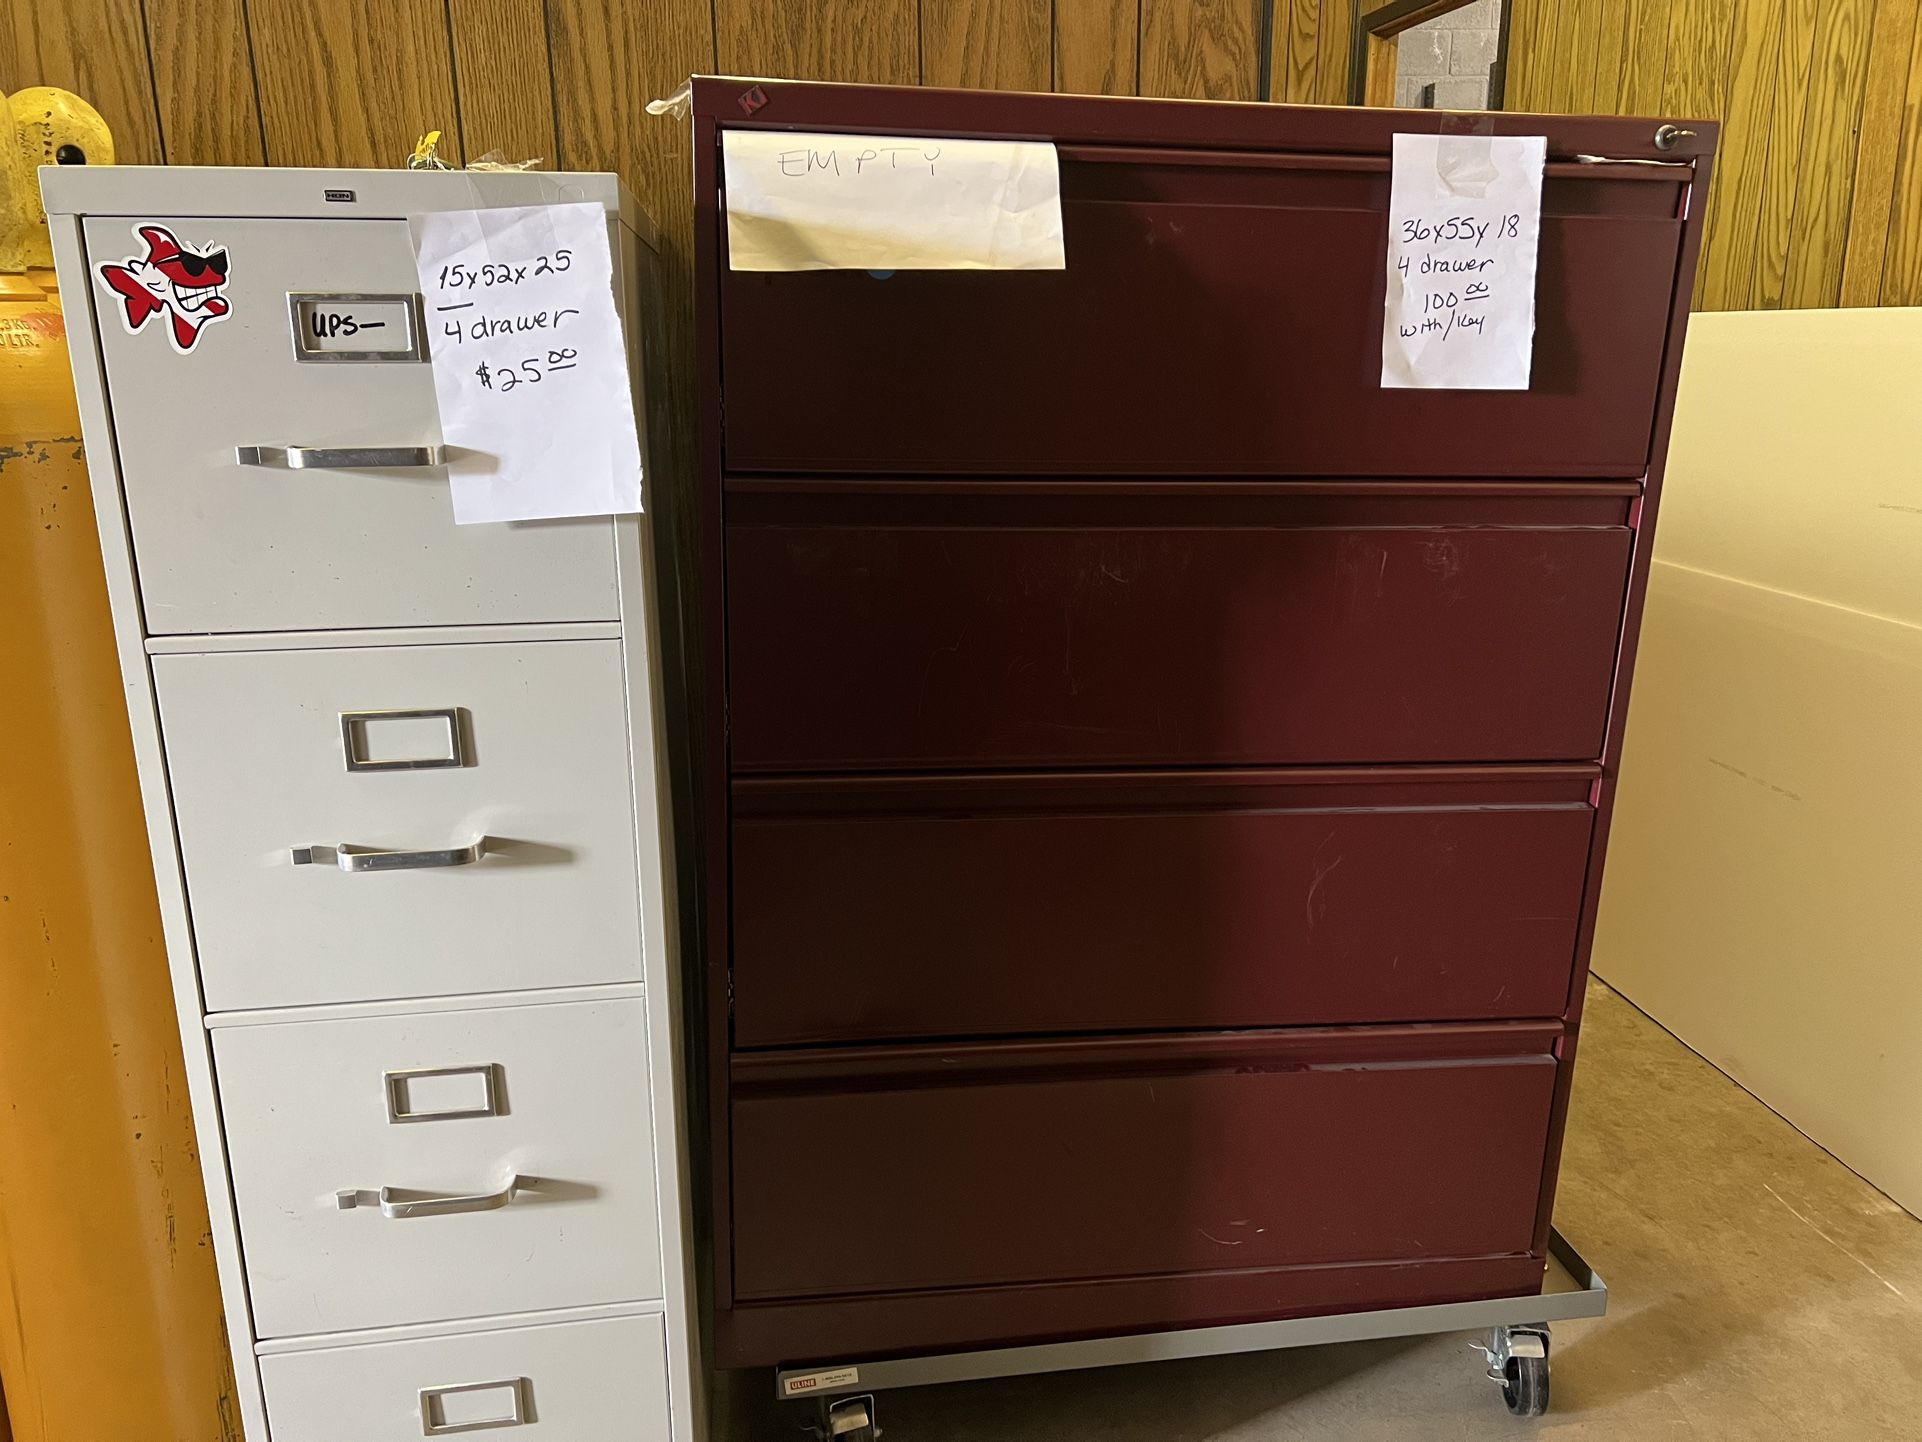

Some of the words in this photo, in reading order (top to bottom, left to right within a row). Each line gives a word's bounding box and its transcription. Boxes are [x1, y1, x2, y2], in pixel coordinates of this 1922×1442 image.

[777, 147, 941, 177] EMPTY
[1397, 256, 1410, 278] 4
[1420, 253, 1495, 274] drawer
[444, 320, 463, 344] 4
[471, 310, 580, 340] drawer
[790, 1378, 817, 1390] ULINE
